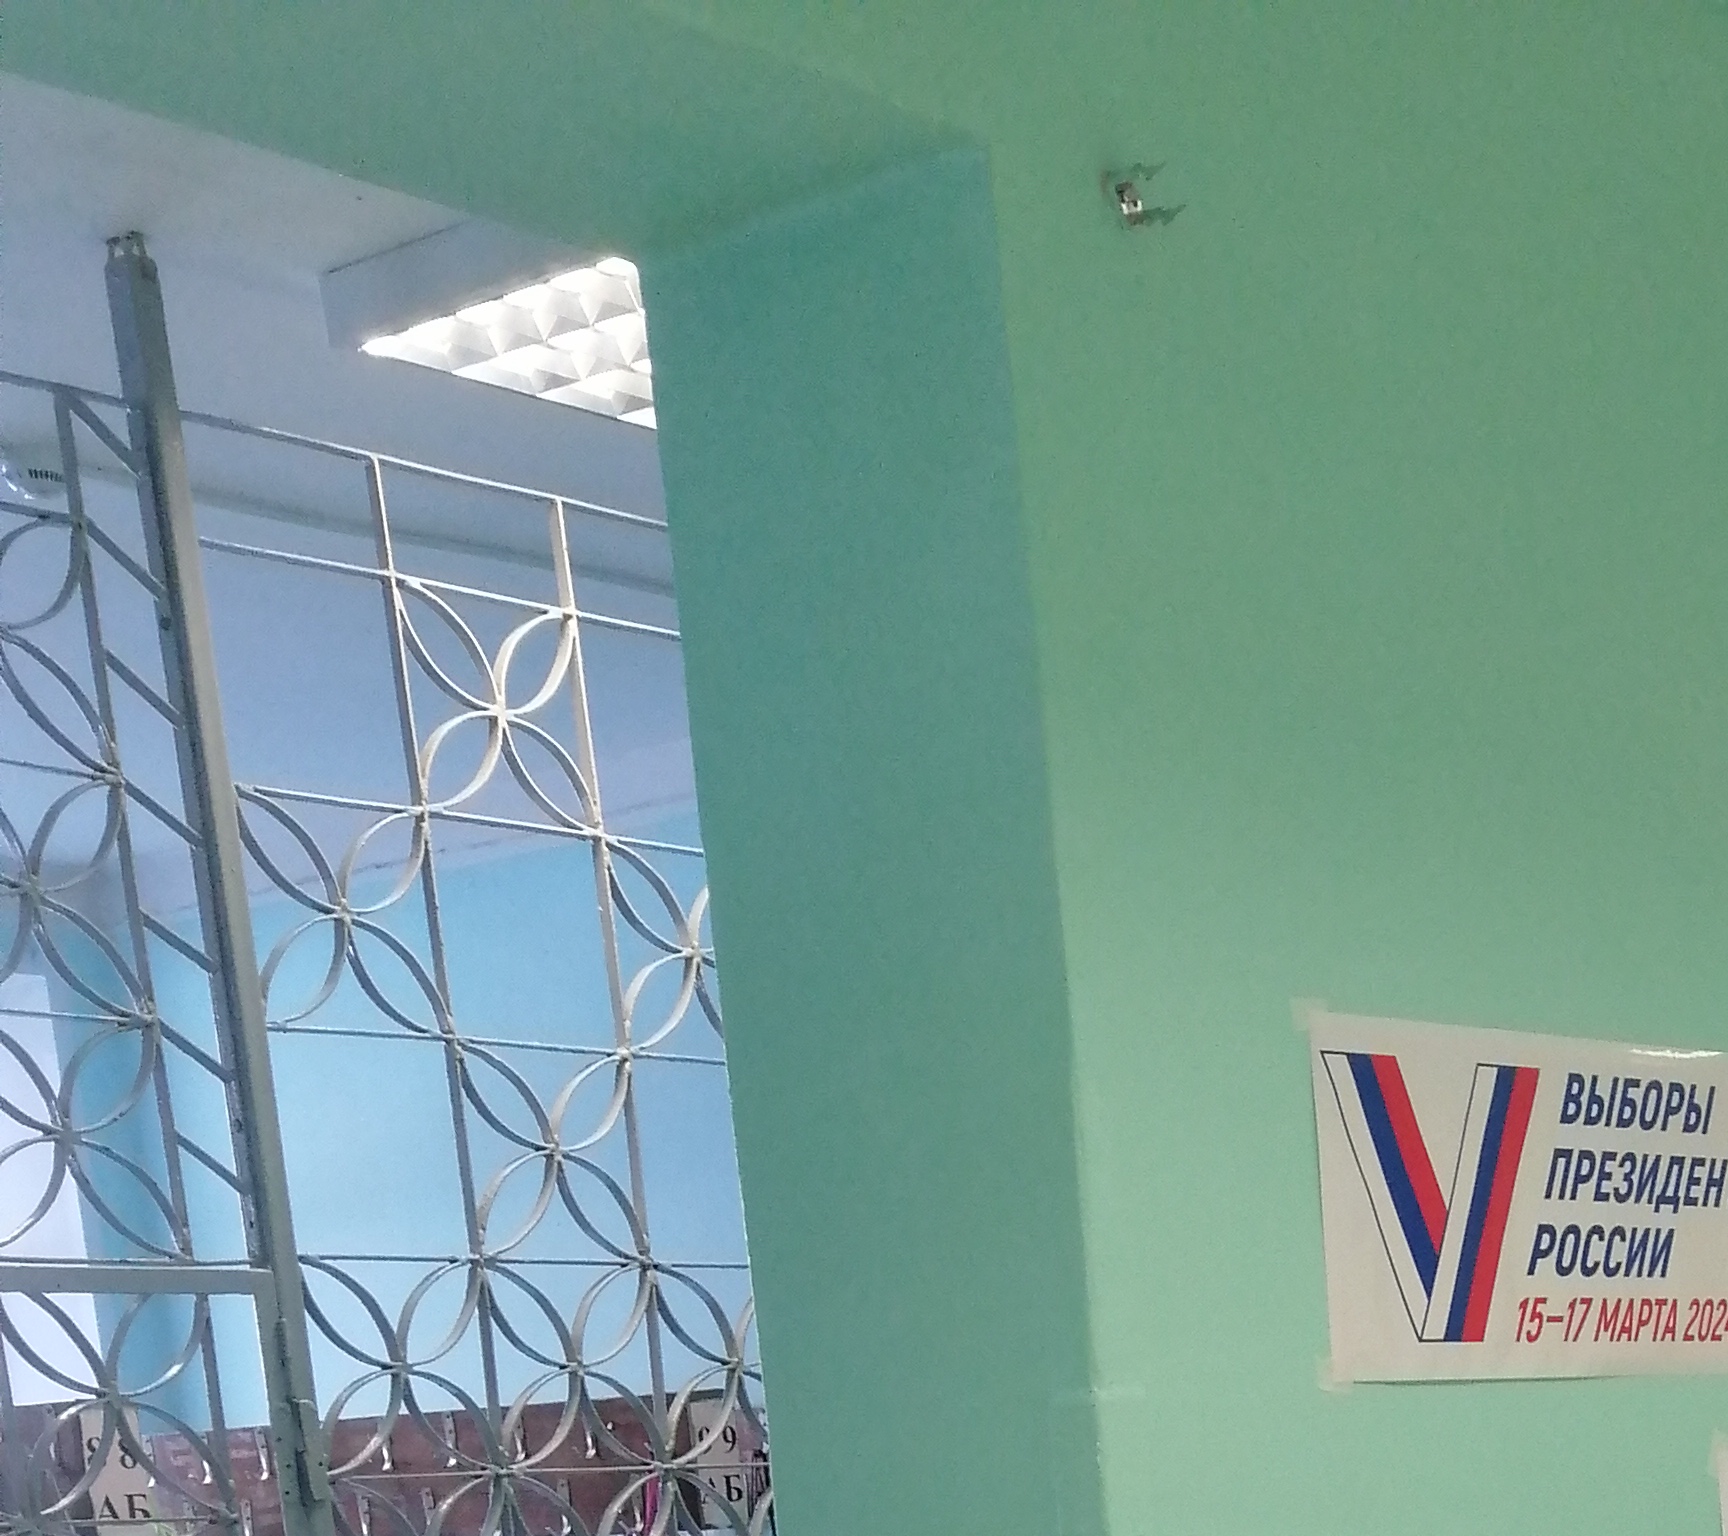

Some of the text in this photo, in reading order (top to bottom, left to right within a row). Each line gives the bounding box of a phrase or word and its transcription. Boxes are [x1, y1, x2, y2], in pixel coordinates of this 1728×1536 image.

[1559, 1072, 1716, 1135] ВЫБОРЫ
[1527, 1223, 1675, 1278] РОССИИ
[1593, 1297, 1678, 1342] МАРТА
[100, 1493, 151, 1520] АБ
